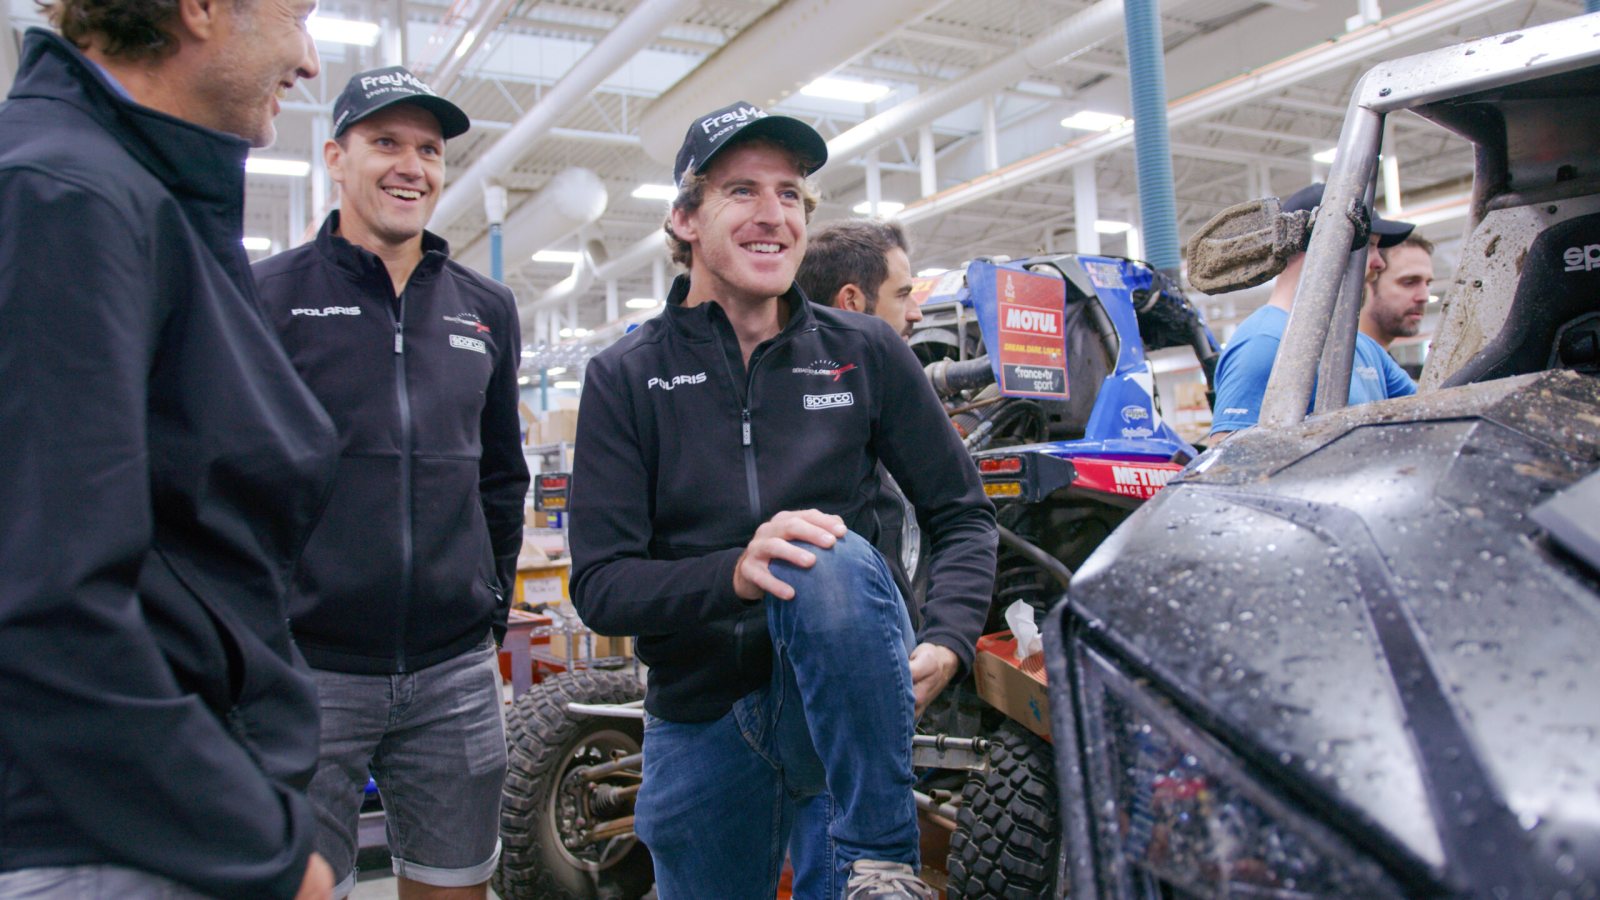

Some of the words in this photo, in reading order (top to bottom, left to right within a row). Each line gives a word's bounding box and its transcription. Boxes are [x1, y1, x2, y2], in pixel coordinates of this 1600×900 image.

[708, 124, 735, 143] SPORT
[291, 306, 362, 317] POLARIS
[1006, 308, 1058, 334] MOTUL
[647, 371, 707, 391] POLARIS
[1033, 380, 1054, 393] sport
[805, 393, 851, 409] sparco
[1116, 484, 1142, 496] RACE
